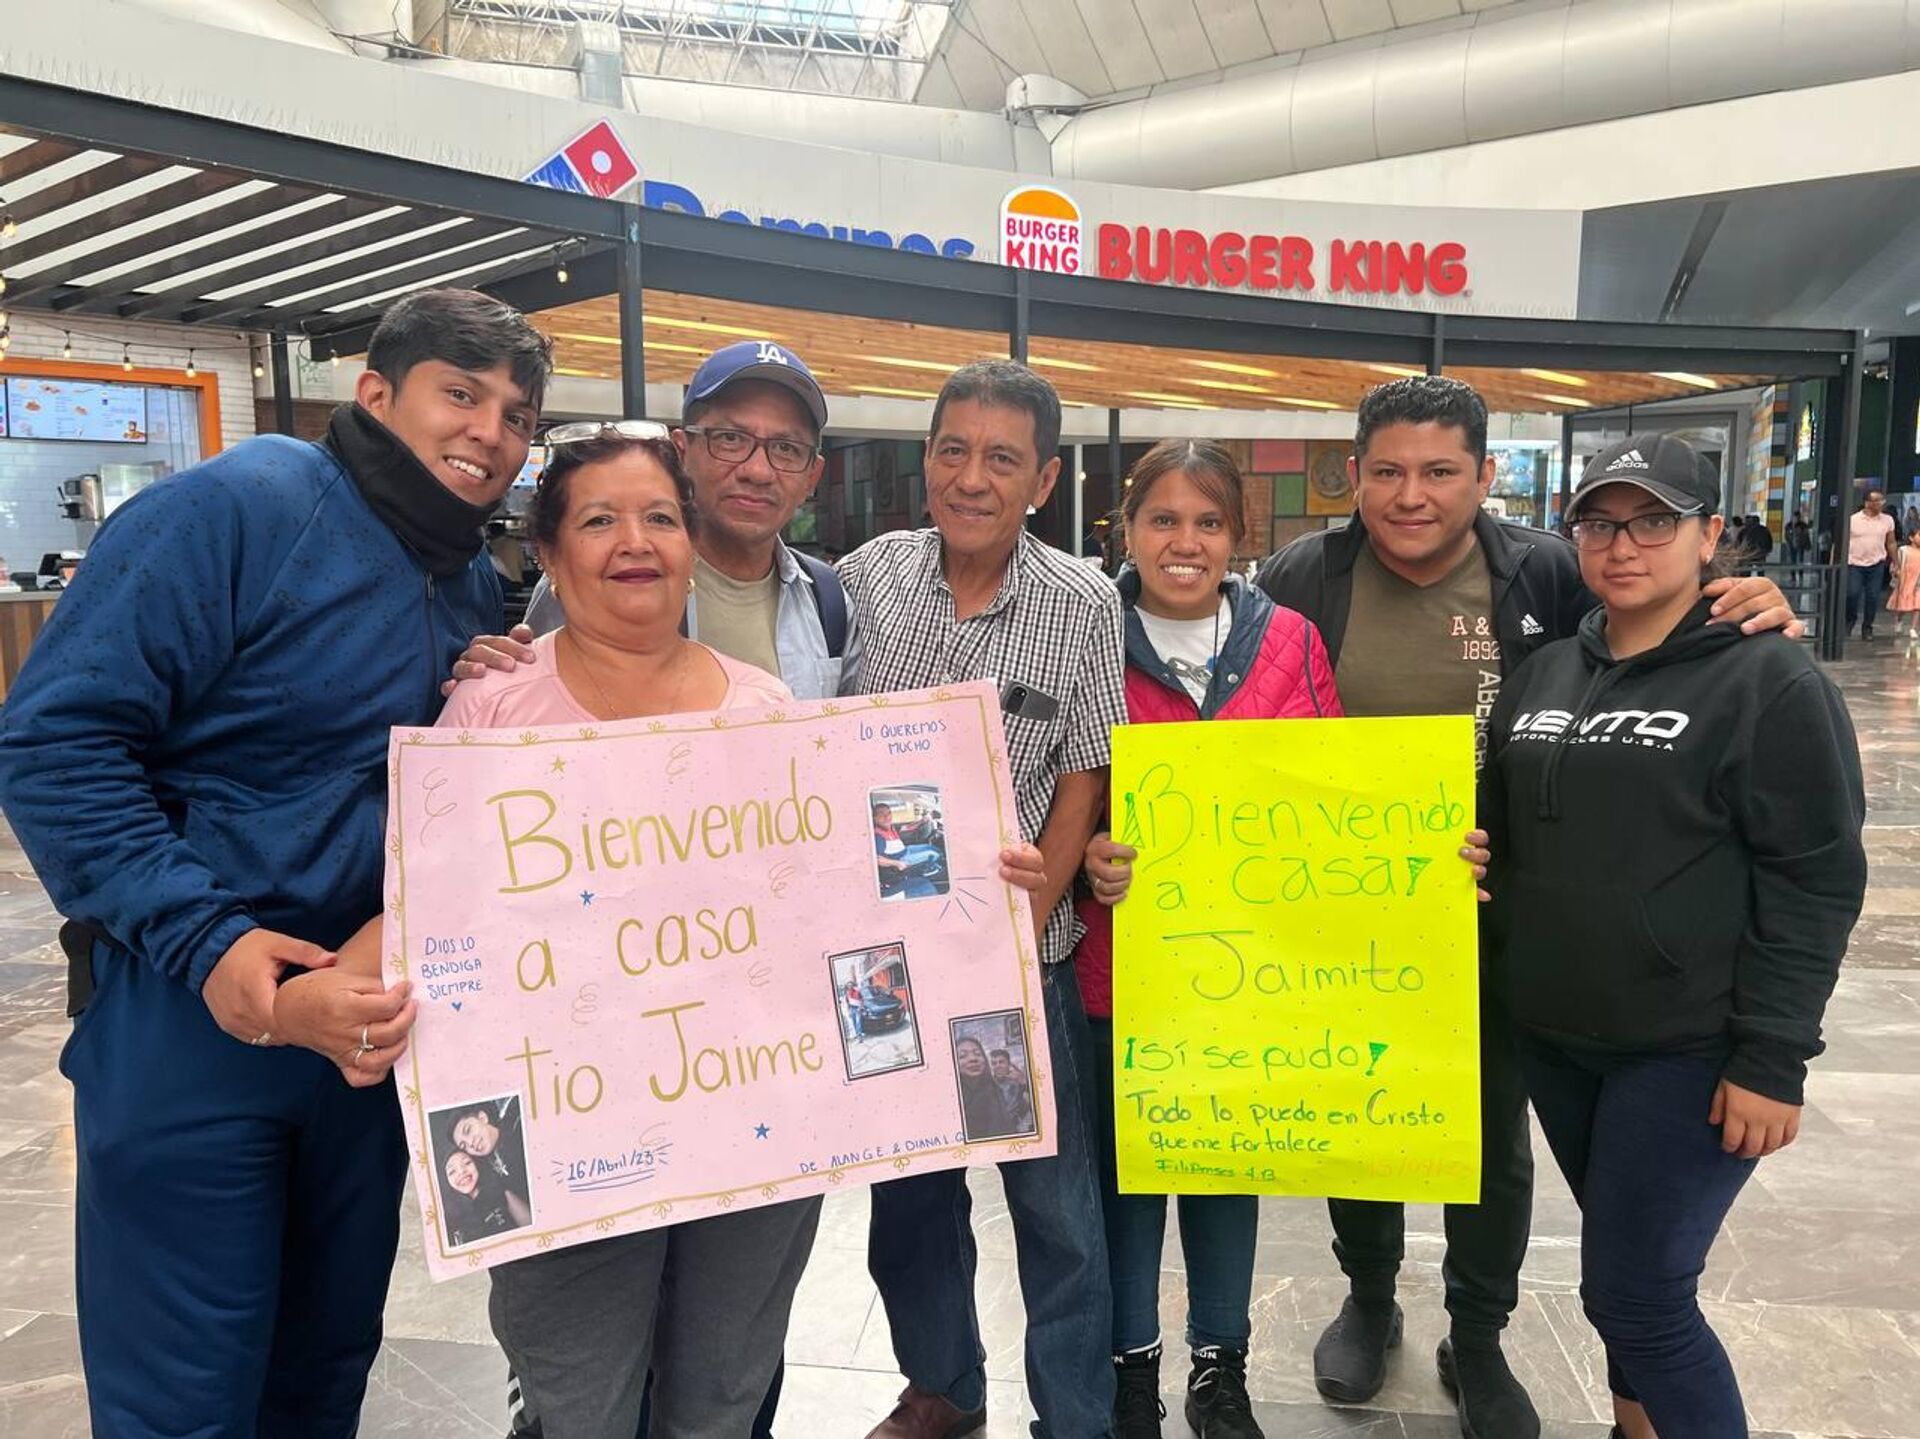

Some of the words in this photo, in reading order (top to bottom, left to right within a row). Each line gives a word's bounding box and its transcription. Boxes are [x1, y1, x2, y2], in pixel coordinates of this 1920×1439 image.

[1006, 217, 1080, 244] BURGER
[1006, 240, 1080, 273] KING
[1098, 222, 1316, 291] BURGER
[1329, 238, 1468, 296] KING
[1451, 616, 1468, 637] A
[1475, 616, 1491, 636] &
[859, 721, 874, 741] LO
[880, 718, 948, 739] QUEREMOS
[888, 739, 931, 755] MUCHO
[485, 756, 833, 894] Bienvenido
[1156, 880, 1188, 911] a
[424, 936, 457, 956] DIOS
[460, 935, 476, 952] LO
[516, 937, 557, 992] a
[616, 905, 758, 977] casa
[420, 958, 482, 979] BENDIGA
[1162, 930, 1424, 1001] Jaimito
[426, 979, 484, 1001] SIEMPRE
[640, 1000, 824, 1103] Jaime
[1202, 1045, 1254, 1069] se
[1125, 1089, 1192, 1124] Todo
[1210, 1094, 1233, 1123] lo
[1249, 1098, 1316, 1127] puedo
[1327, 1111, 1358, 1125] en
[1366, 1088, 1445, 1127] Cristo
